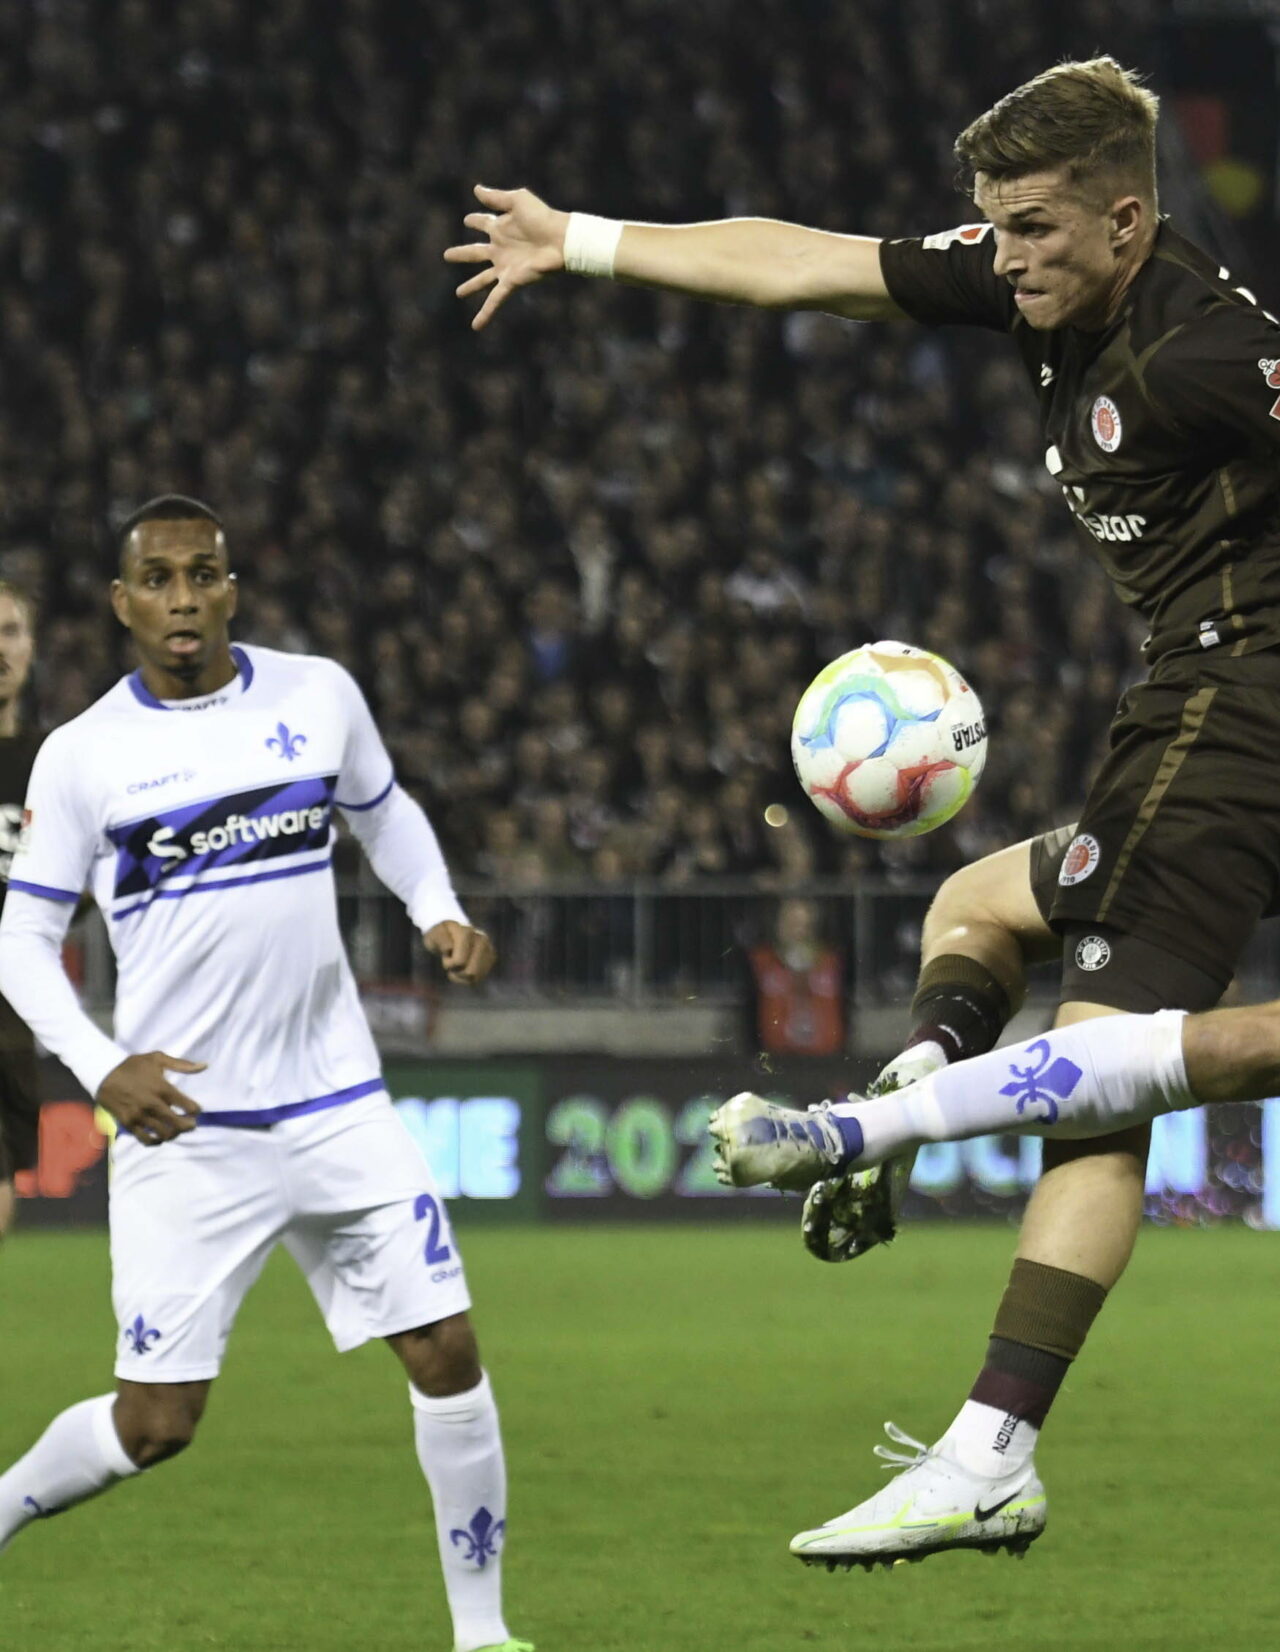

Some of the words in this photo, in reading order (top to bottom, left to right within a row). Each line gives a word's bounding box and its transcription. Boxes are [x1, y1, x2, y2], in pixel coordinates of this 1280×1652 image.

[1080, 513, 1147, 542] star
[127, 773, 180, 795] CRAFT
[190, 806, 325, 855] software
